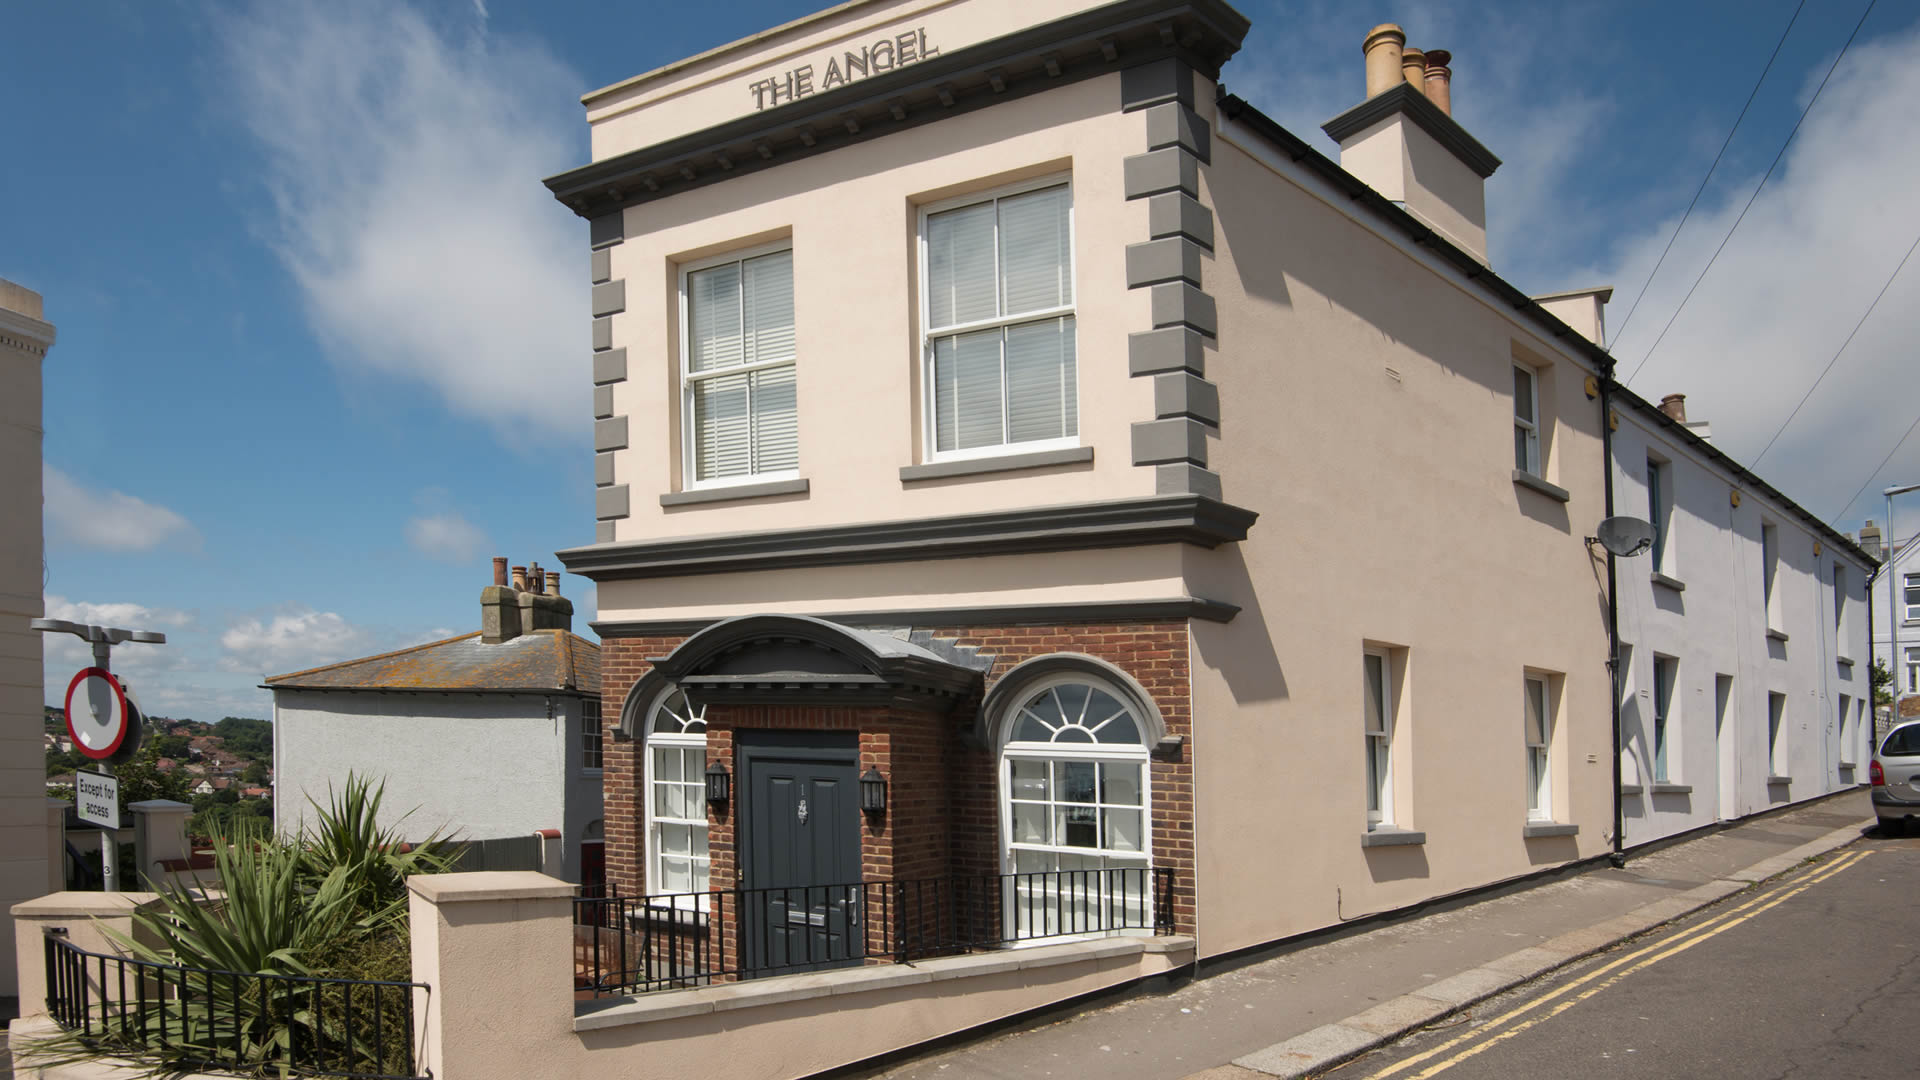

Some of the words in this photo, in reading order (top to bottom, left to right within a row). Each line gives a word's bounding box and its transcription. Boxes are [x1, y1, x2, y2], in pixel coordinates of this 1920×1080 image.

[749, 64, 815, 110] THE
[822, 27, 941, 89] ANGEL
[80, 778, 103, 799] Except
[104, 783, 115, 800] for
[86, 802, 109, 819] access
[104, 865, 111, 875] 3
